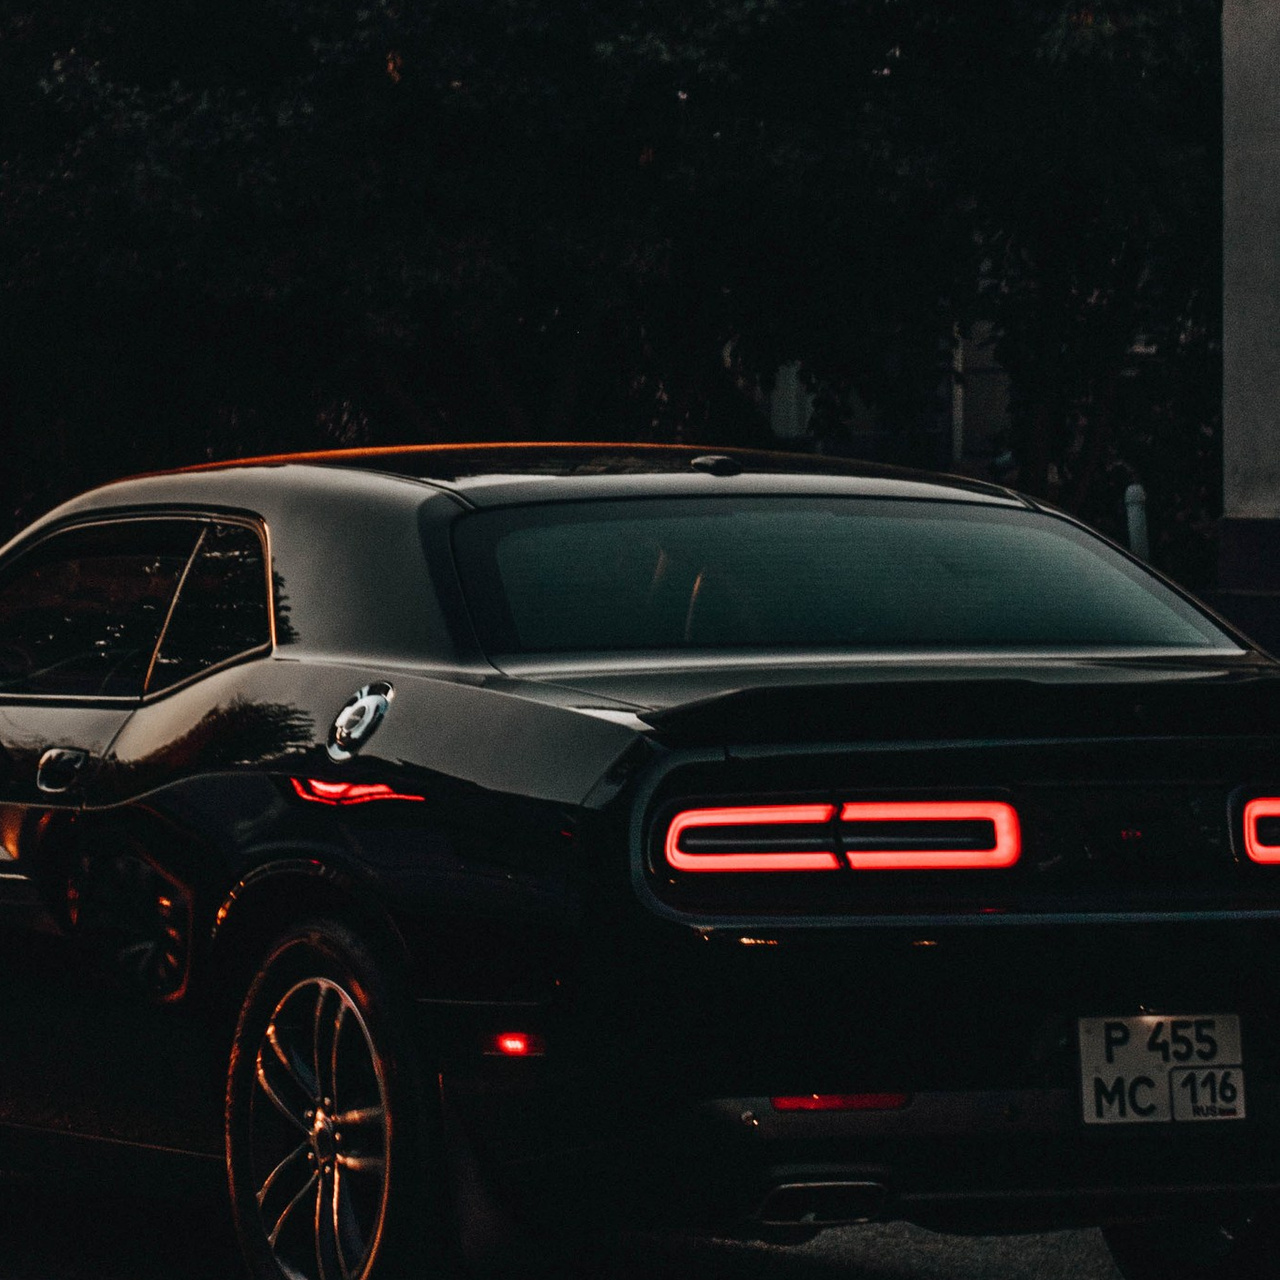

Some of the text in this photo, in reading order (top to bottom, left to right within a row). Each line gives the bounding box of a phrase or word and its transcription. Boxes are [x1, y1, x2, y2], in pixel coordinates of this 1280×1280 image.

[1147, 1020, 1218, 1063] 455
[1093, 1070, 1237, 1118] MC 116
